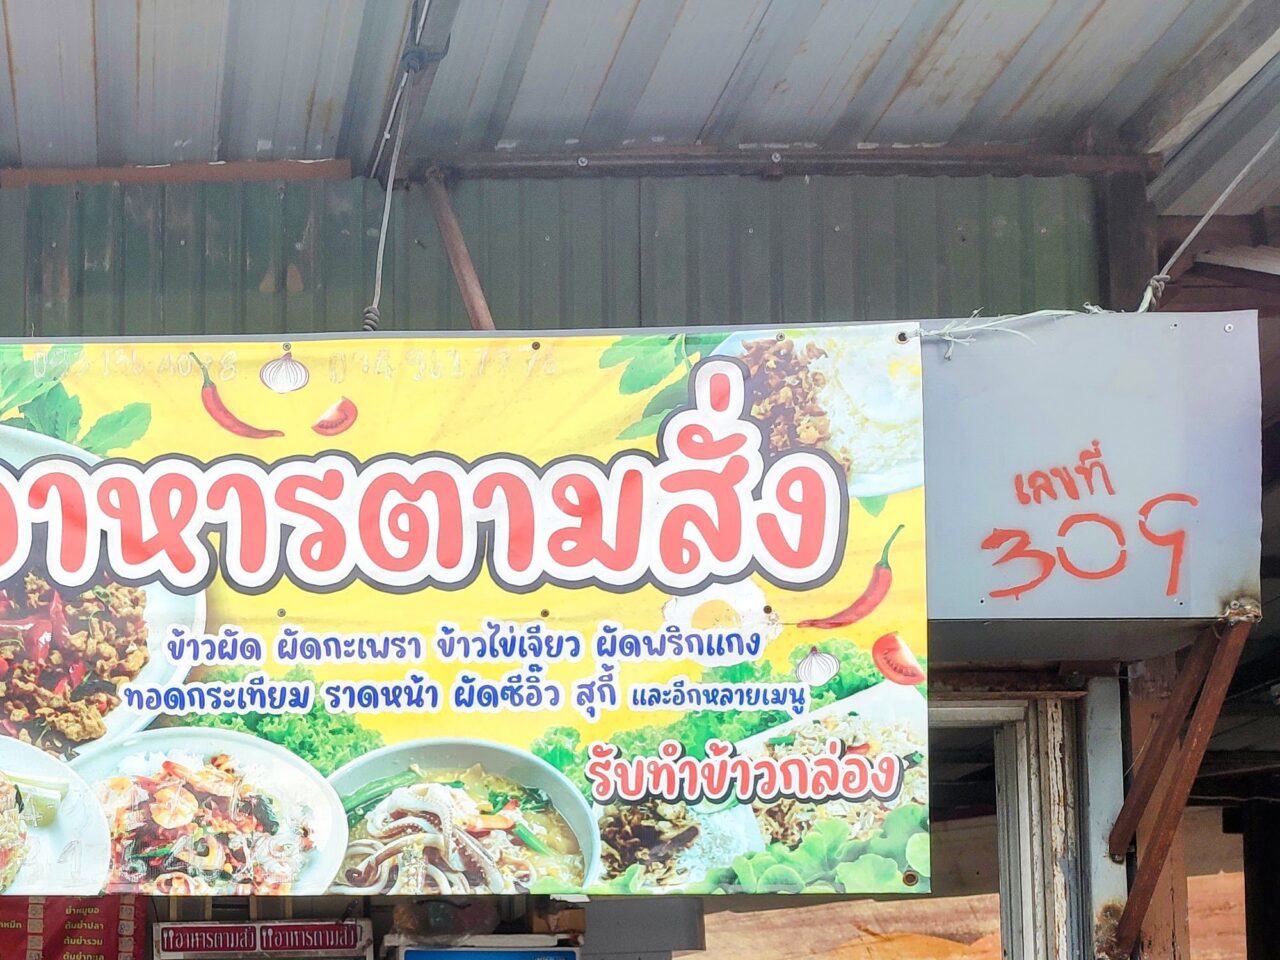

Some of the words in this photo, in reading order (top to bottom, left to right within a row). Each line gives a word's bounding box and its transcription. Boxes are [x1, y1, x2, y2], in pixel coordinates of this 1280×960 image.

[1015, 439, 1115, 504] เลขที่
[980, 493, 1199, 600] 309
[168, 628, 262, 661] ข้าวผัด
[277, 628, 422, 660] ผัดกะเพรา
[437, 622, 580, 658] ข้าวไข่เจียว
[597, 623, 761, 658] ผัดพริกแกง
[124, 676, 310, 711] ทอดกระเทียม
[326, 675, 438, 709] ราดหน้า
[454, 664, 559, 708] ผัดซีอิ๊ว
[576, 664, 616, 717] สุกี้
[633, 680, 805, 714] และอีกหลายเมนู
[586, 739, 901, 799] รับทำข้าวกล่อง
